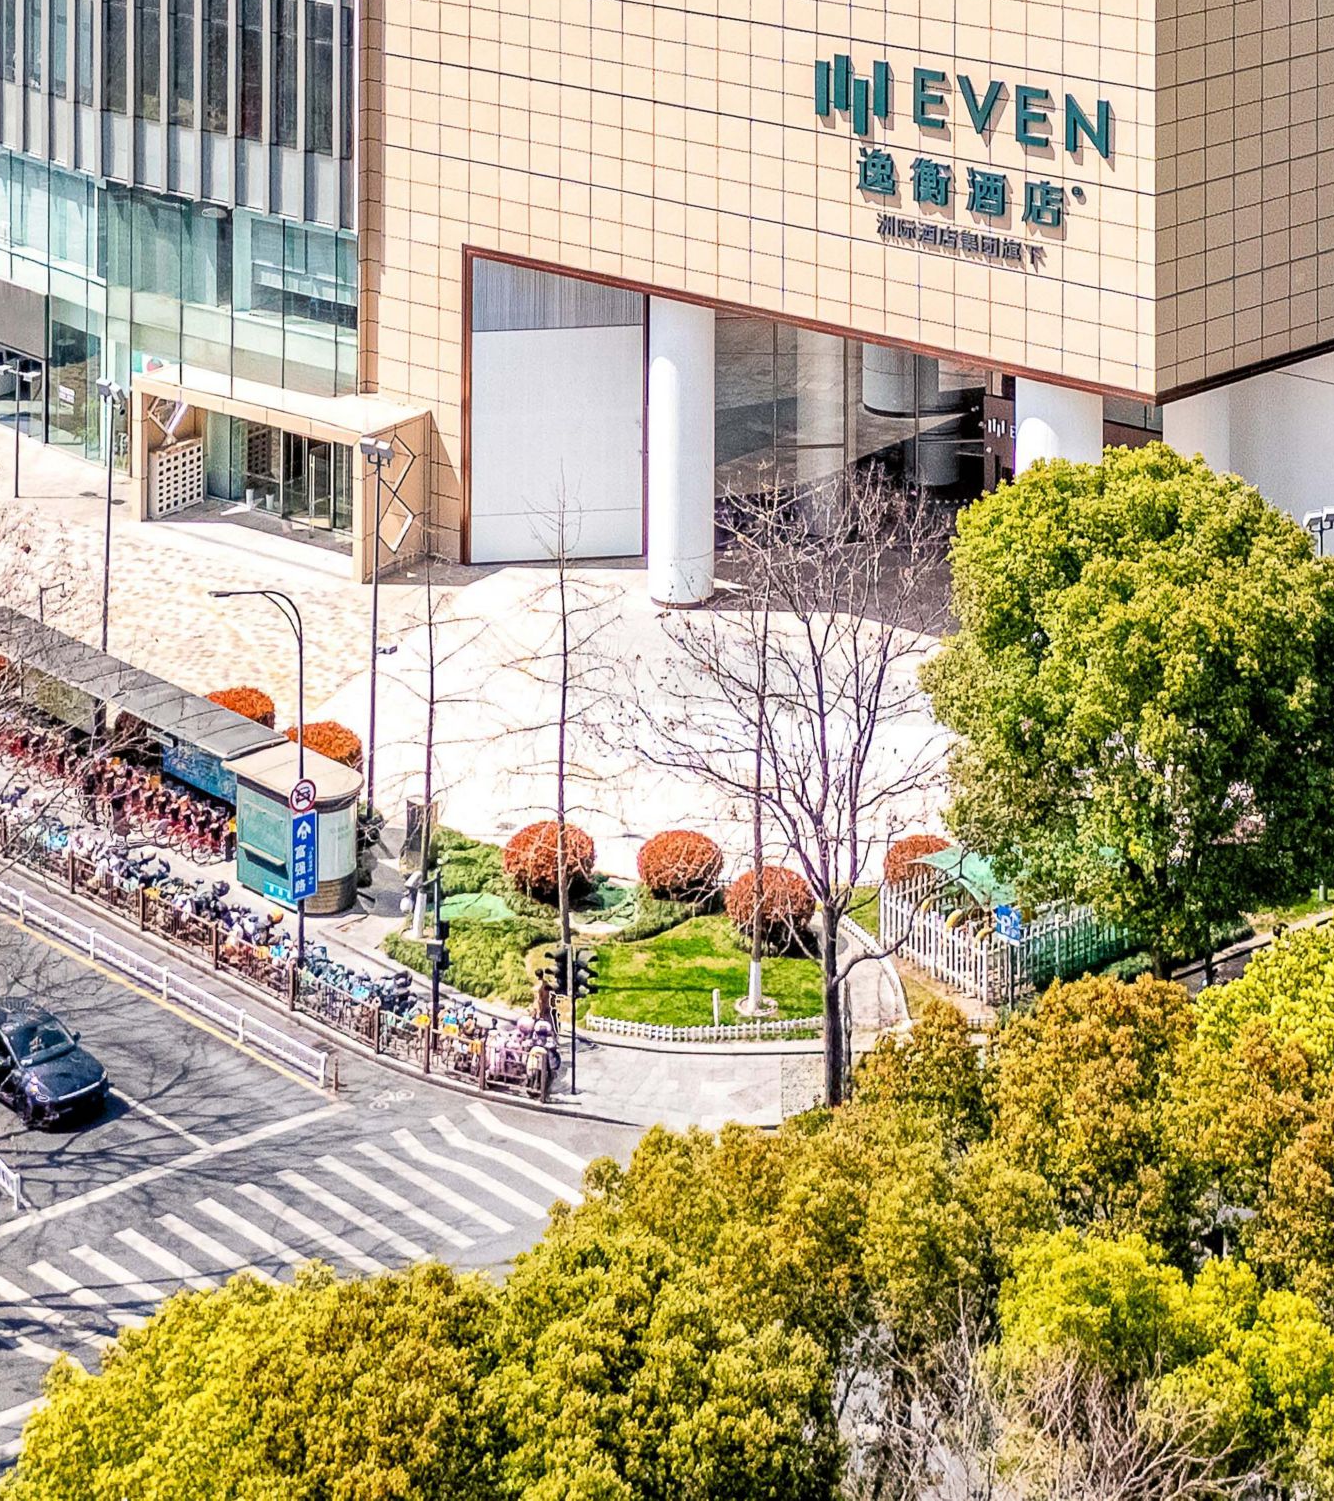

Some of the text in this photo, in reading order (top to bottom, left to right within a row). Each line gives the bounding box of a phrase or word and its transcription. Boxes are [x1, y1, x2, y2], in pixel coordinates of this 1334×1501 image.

[914, 66, 1109, 158] EVEN
[856, 146, 1064, 228] 逸衡酒店
[876, 212, 1044, 265] 洲际酒店集团旗下
